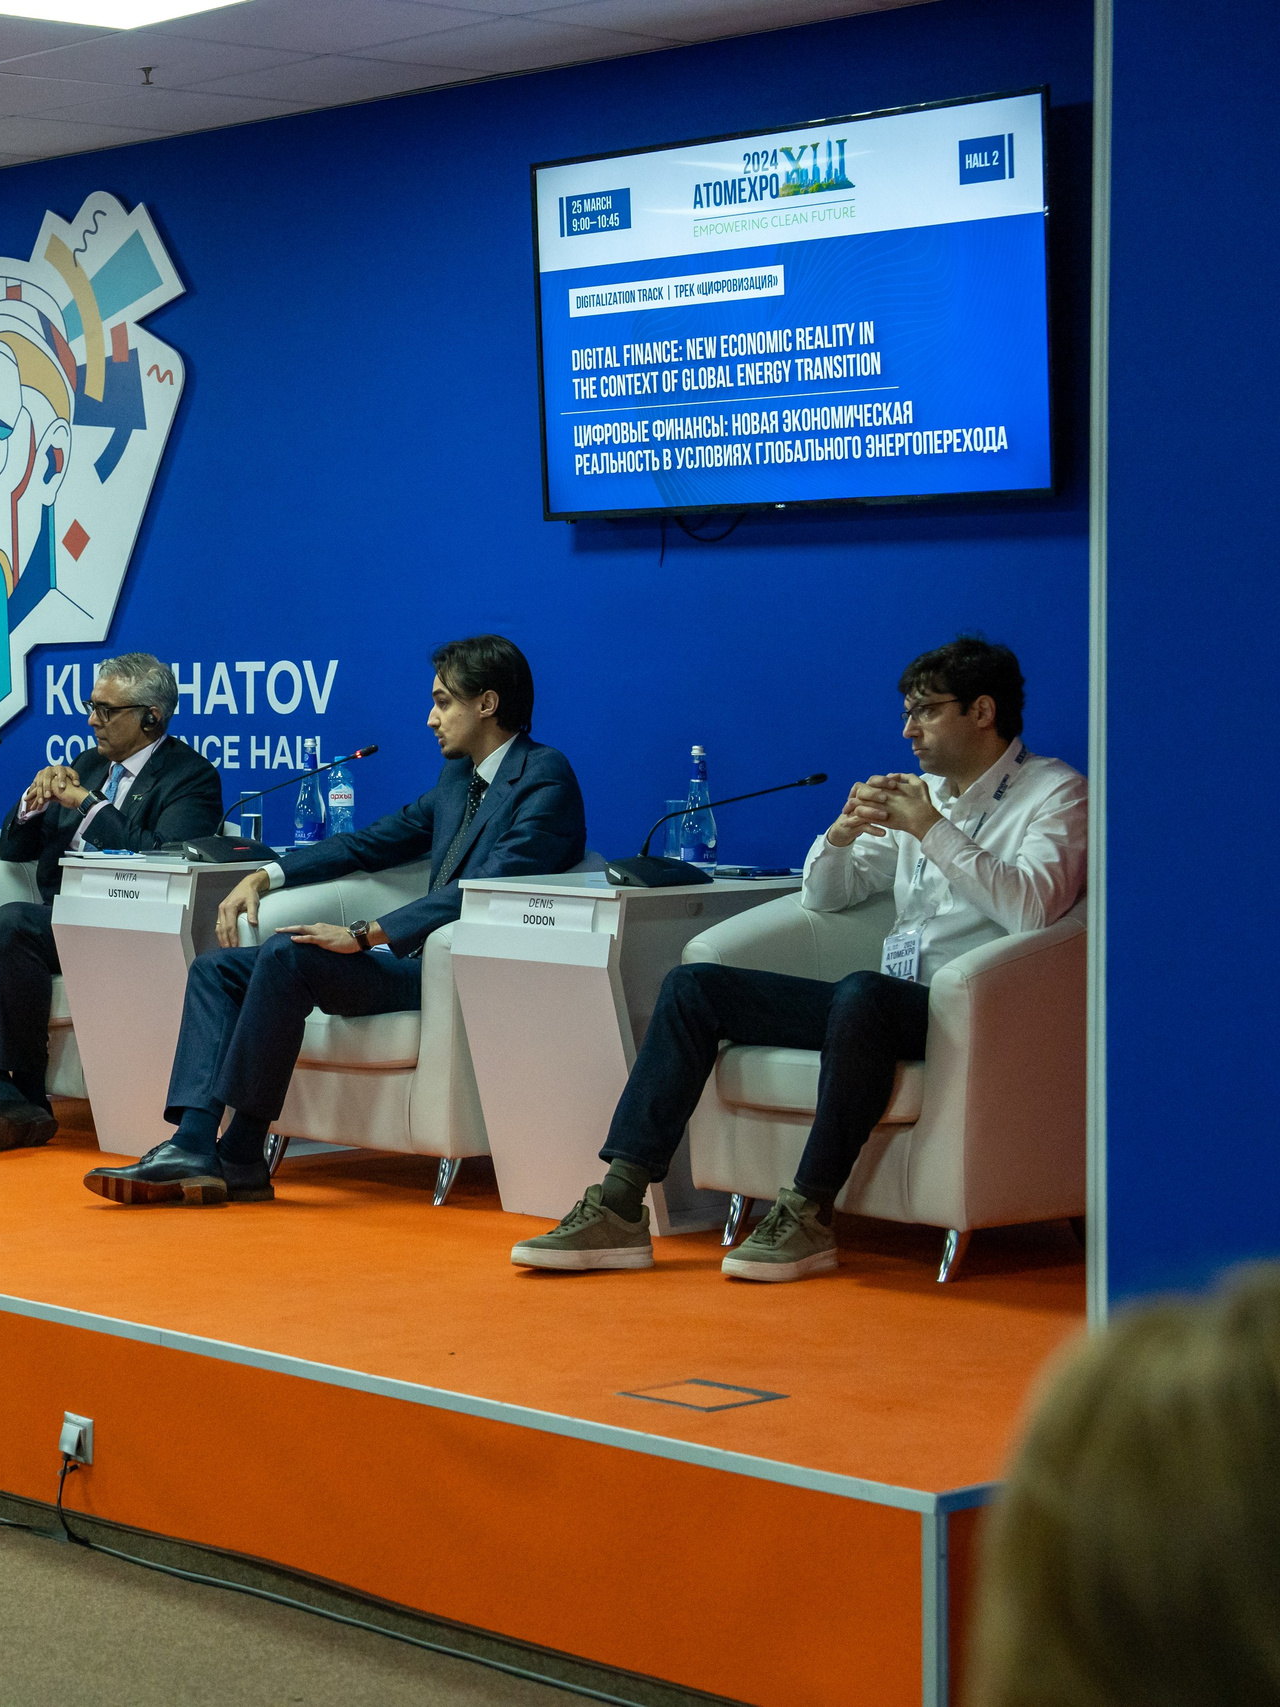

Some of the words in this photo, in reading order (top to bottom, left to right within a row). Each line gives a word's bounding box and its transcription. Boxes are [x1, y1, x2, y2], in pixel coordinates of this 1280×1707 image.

[743, 149, 778, 174] 2024
[966, 152, 990, 169] HALL
[992, 150, 999, 166] 2
[572, 200, 581, 214] 25
[584, 196, 612, 212] MARCH
[693, 173, 779, 209] ATOMEXPO
[694, 218, 768, 237] EMPOWERING
[771, 212, 808, 228] CLEAN
[812, 206, 856, 222] FUTURE
[576, 290, 636, 309] DIGITALIZATION
[637, 286, 664, 302] TRACK
[674, 283, 695, 298] ТРЕК
[697, 274, 778, 296] «ЦИФРОВИЗАЦИЯ»
[572, 346, 620, 371] DIGITAL
[624, 340, 682, 366] FINANCE:
[686, 336, 717, 360] NEW
[721, 328, 792, 357] ECONOMIC
[796, 322, 855, 350] REALITY
[859, 320, 874, 345] IN
[572, 377, 597, 400] THE
[600, 371, 658, 398] CONTEXT
[662, 370, 678, 392] OF
[682, 365, 734, 391] GLOBAL
[737, 360, 792, 386] ENERGY
[795, 352, 881, 381] TRANSITION
[574, 420, 649, 448] ЦИФРОВЫЕ
[652, 415, 728, 441] ФИНАНСЫ:
[732, 410, 778, 436] НОВАЯ
[782, 400, 913, 432] ЭКОНОМИЧЕСКАЯ
[575, 450, 660, 476] РЕАЛЬНОСТЬ
[663, 448, 672, 470] В
[675, 443, 752, 470] УСЛОВИЯХ
[756, 436, 862, 464] ГЛОБАЛЬНОГО
[866, 426, 1008, 458] ЭНЕРГОПЕРЕХОДА
[46, 659, 339, 715] KUHATOV
[115, 872, 137, 882] NIKITA
[108, 889, 140, 899] USTINOV
[528, 898, 554, 909] DENIS
[523, 914, 555, 926] DODON
